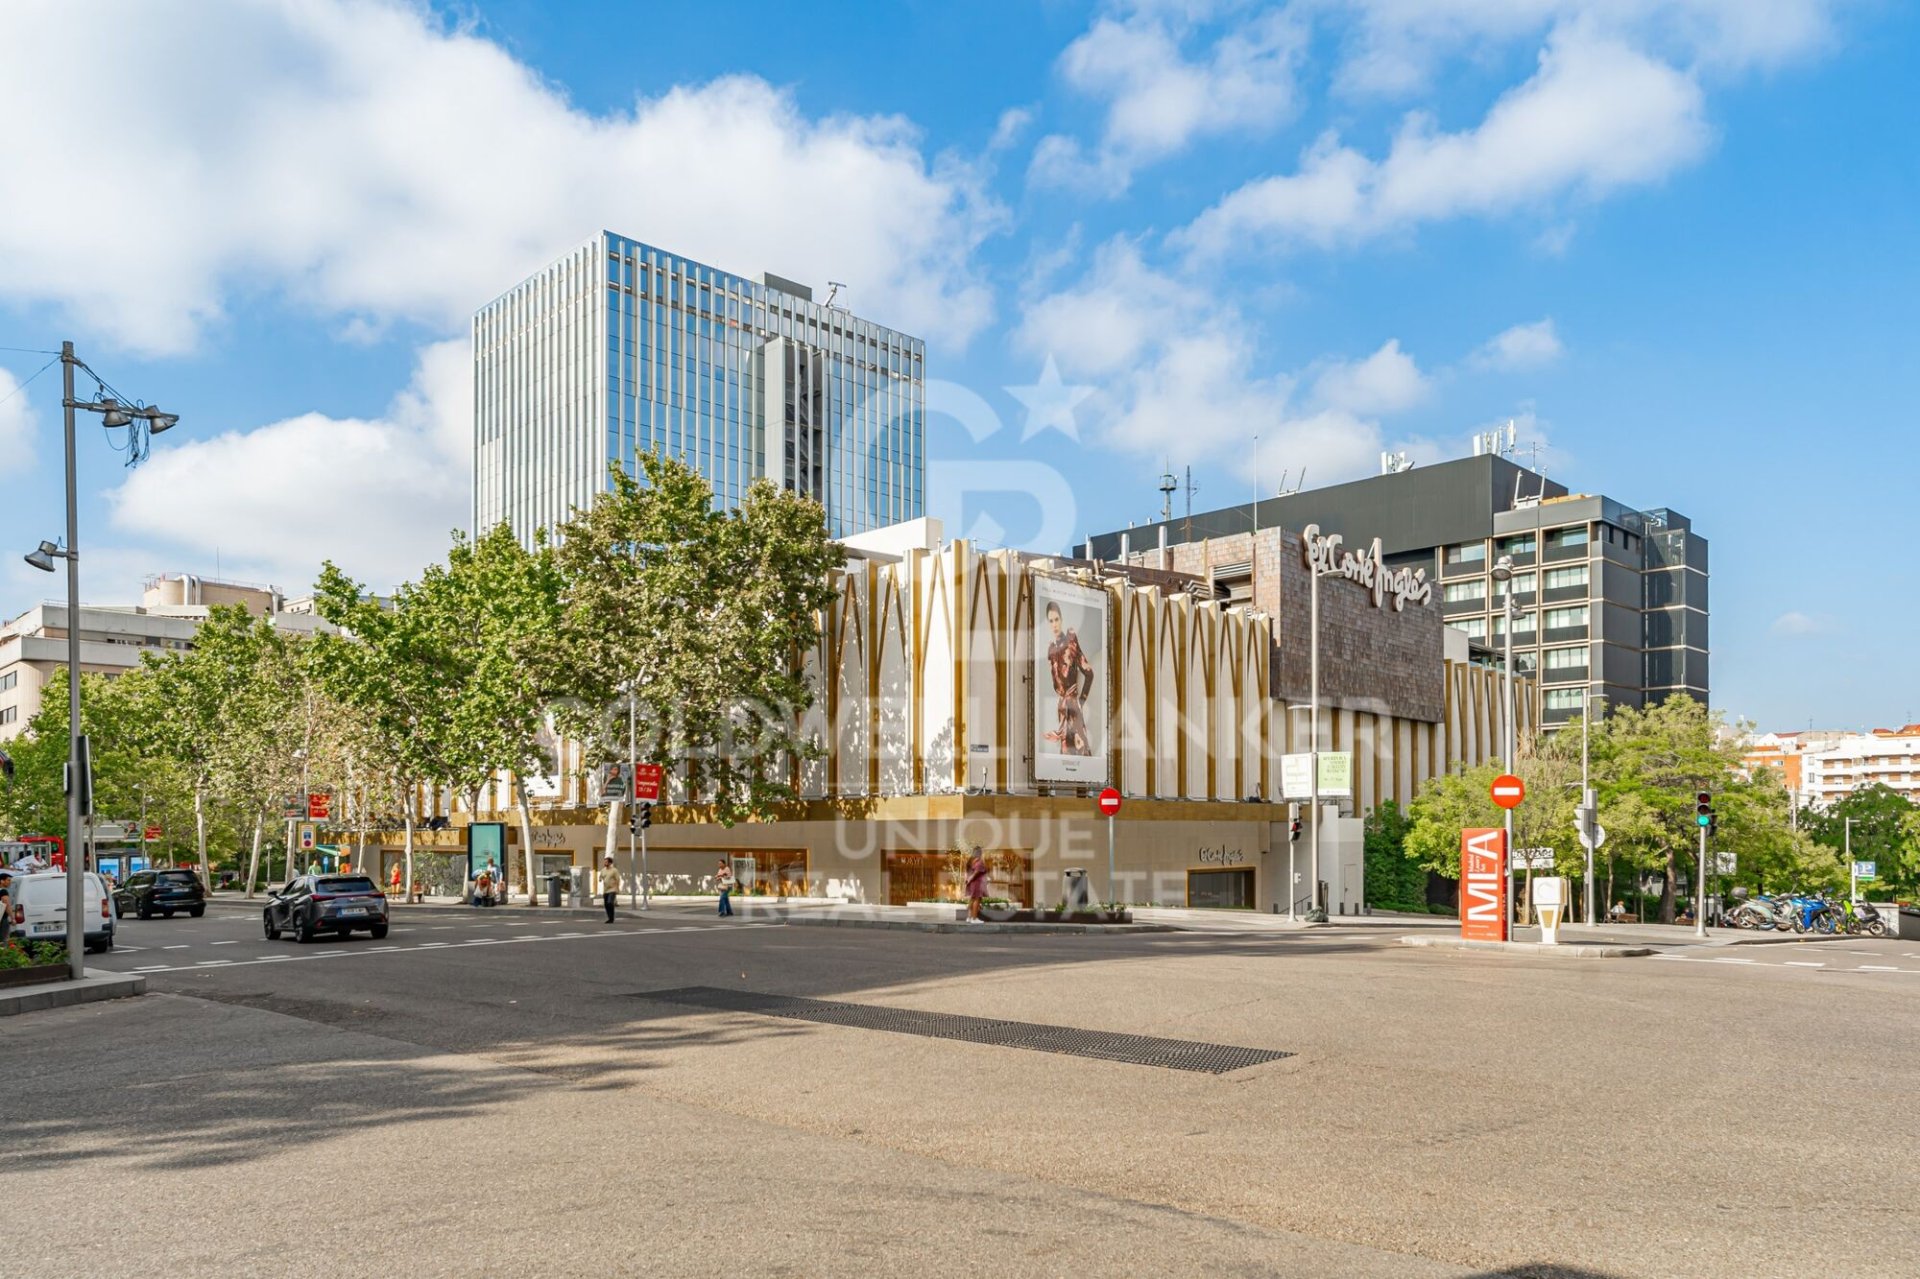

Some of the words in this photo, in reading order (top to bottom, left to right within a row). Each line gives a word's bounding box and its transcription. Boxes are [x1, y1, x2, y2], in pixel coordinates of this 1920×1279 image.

[1303, 523, 1327, 571] El
[1326, 533, 1374, 589] Corte
[1367, 537, 1432, 612] Inglés
